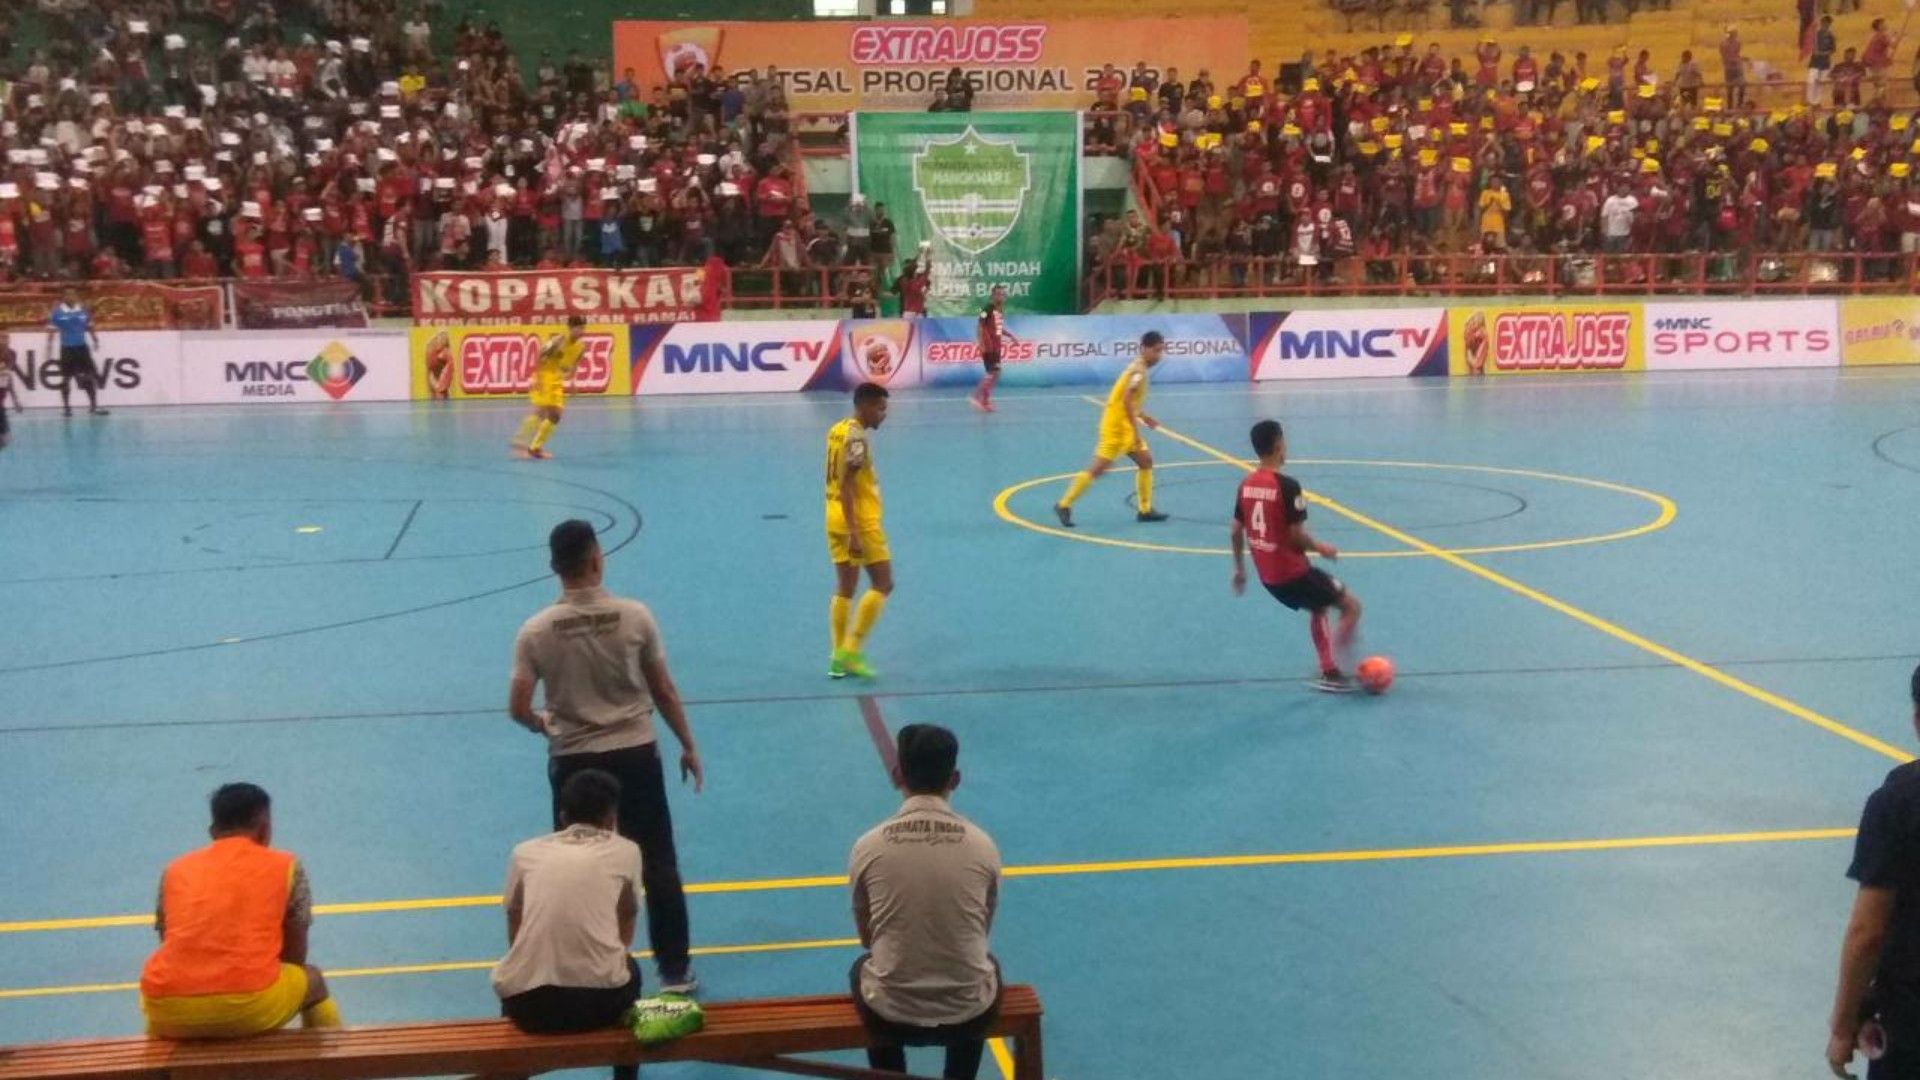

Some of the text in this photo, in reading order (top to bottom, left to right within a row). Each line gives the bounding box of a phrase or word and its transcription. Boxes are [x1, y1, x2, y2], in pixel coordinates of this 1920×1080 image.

[852, 27, 1046, 64] EXTRAJOSS
[864, 69, 1074, 92] PROFSIONAL
[987, 261, 1041, 276] INDAH
[1665, 317, 1712, 330] MNC
[1037, 340, 1107, 358] FUTSAL
[1495, 311, 1631, 370] EXTRAJOSS
[1653, 330, 1830, 355] SPORTS
[224, 361, 312, 382] MNC
[242, 384, 296, 396] MEDIA
[1250, 500, 1267, 538] 4
